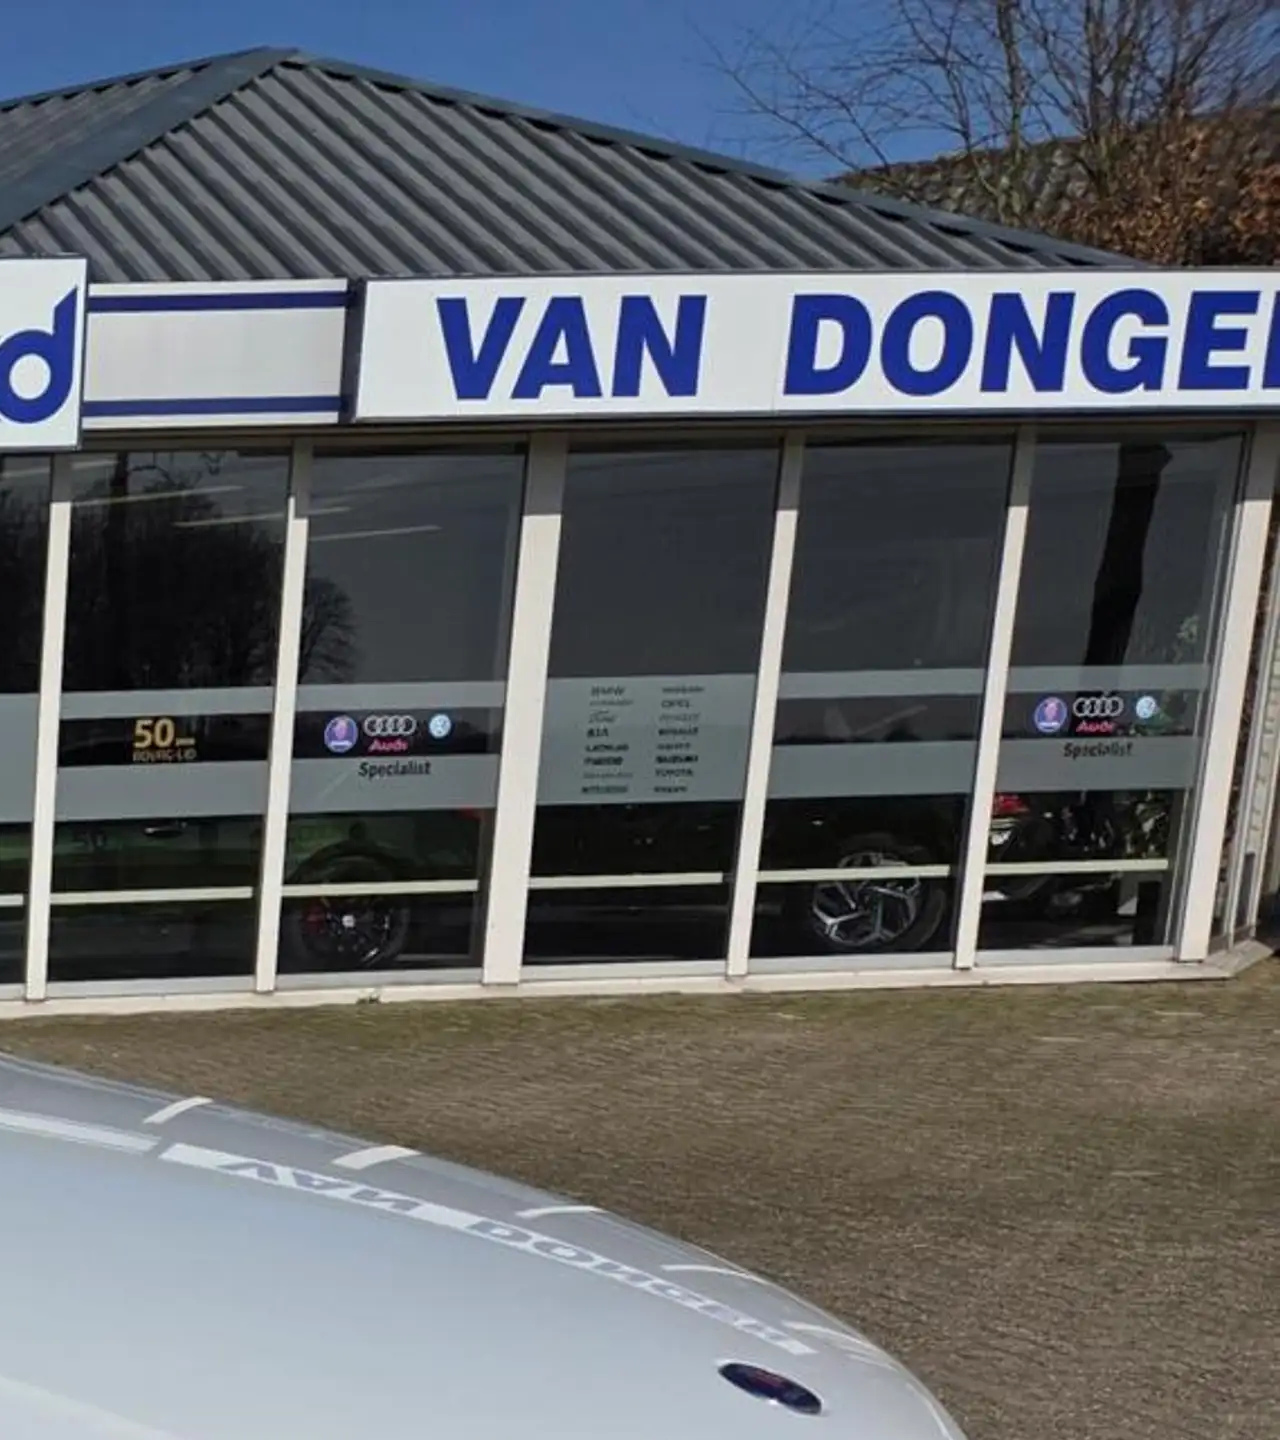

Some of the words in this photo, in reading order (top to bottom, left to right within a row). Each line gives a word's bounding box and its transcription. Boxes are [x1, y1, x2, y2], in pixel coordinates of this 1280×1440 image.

[436, 294, 707, 400] VAN
[783, 289, 1280, 397] DONGE
[133, 718, 176, 749] 50
[1063, 742, 1134, 760] Specialist
[358, 760, 432, 780] Specialist
